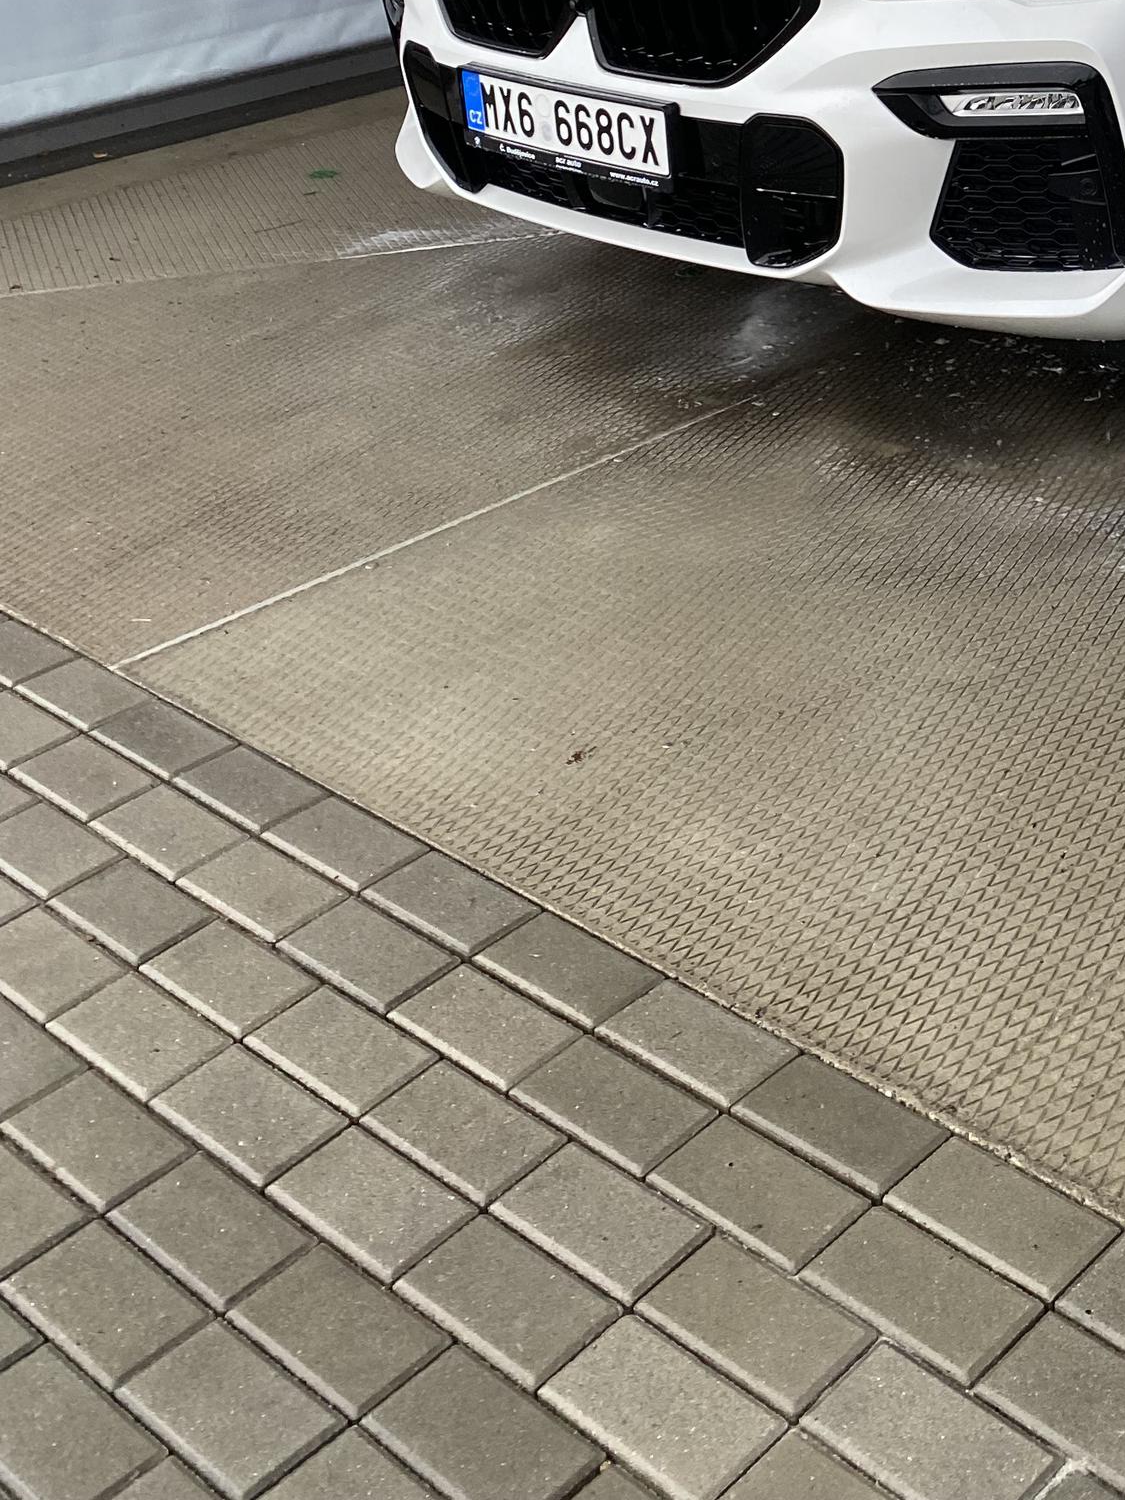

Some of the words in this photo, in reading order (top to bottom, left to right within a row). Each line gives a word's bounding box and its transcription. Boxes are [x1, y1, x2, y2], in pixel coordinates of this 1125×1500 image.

[469, 109, 483, 124] CZ
[480, 82, 535, 138] MX6
[554, 99, 659, 166] 668CX
